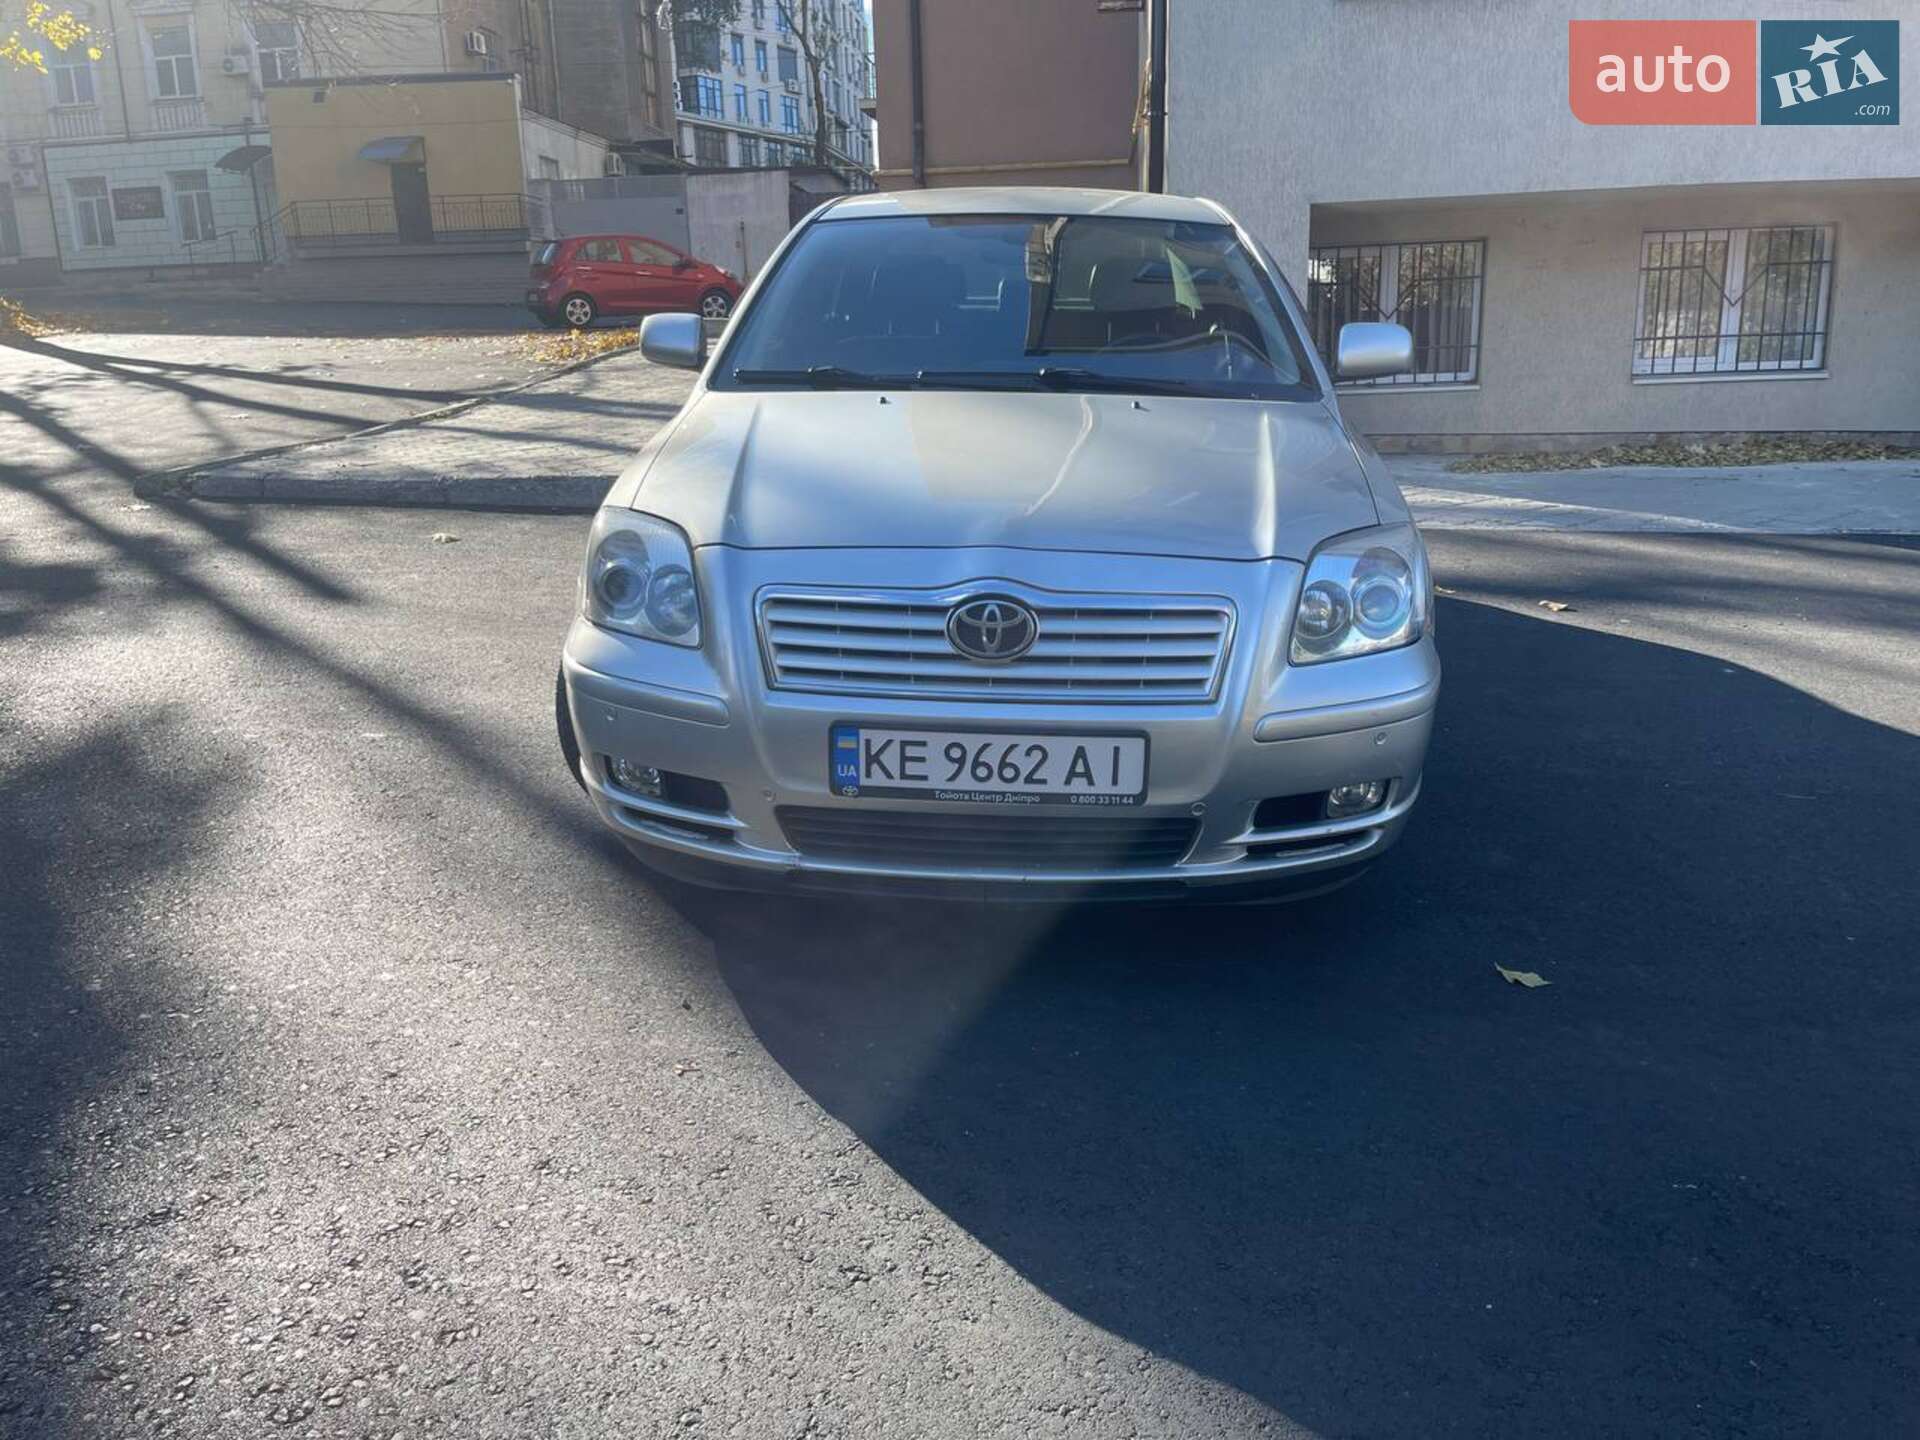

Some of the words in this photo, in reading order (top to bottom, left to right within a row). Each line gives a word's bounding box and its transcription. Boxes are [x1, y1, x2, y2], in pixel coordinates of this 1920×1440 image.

[838, 764, 857, 777] UA
[863, 738, 929, 781] KE
[944, 741, 1049, 785] 9662
